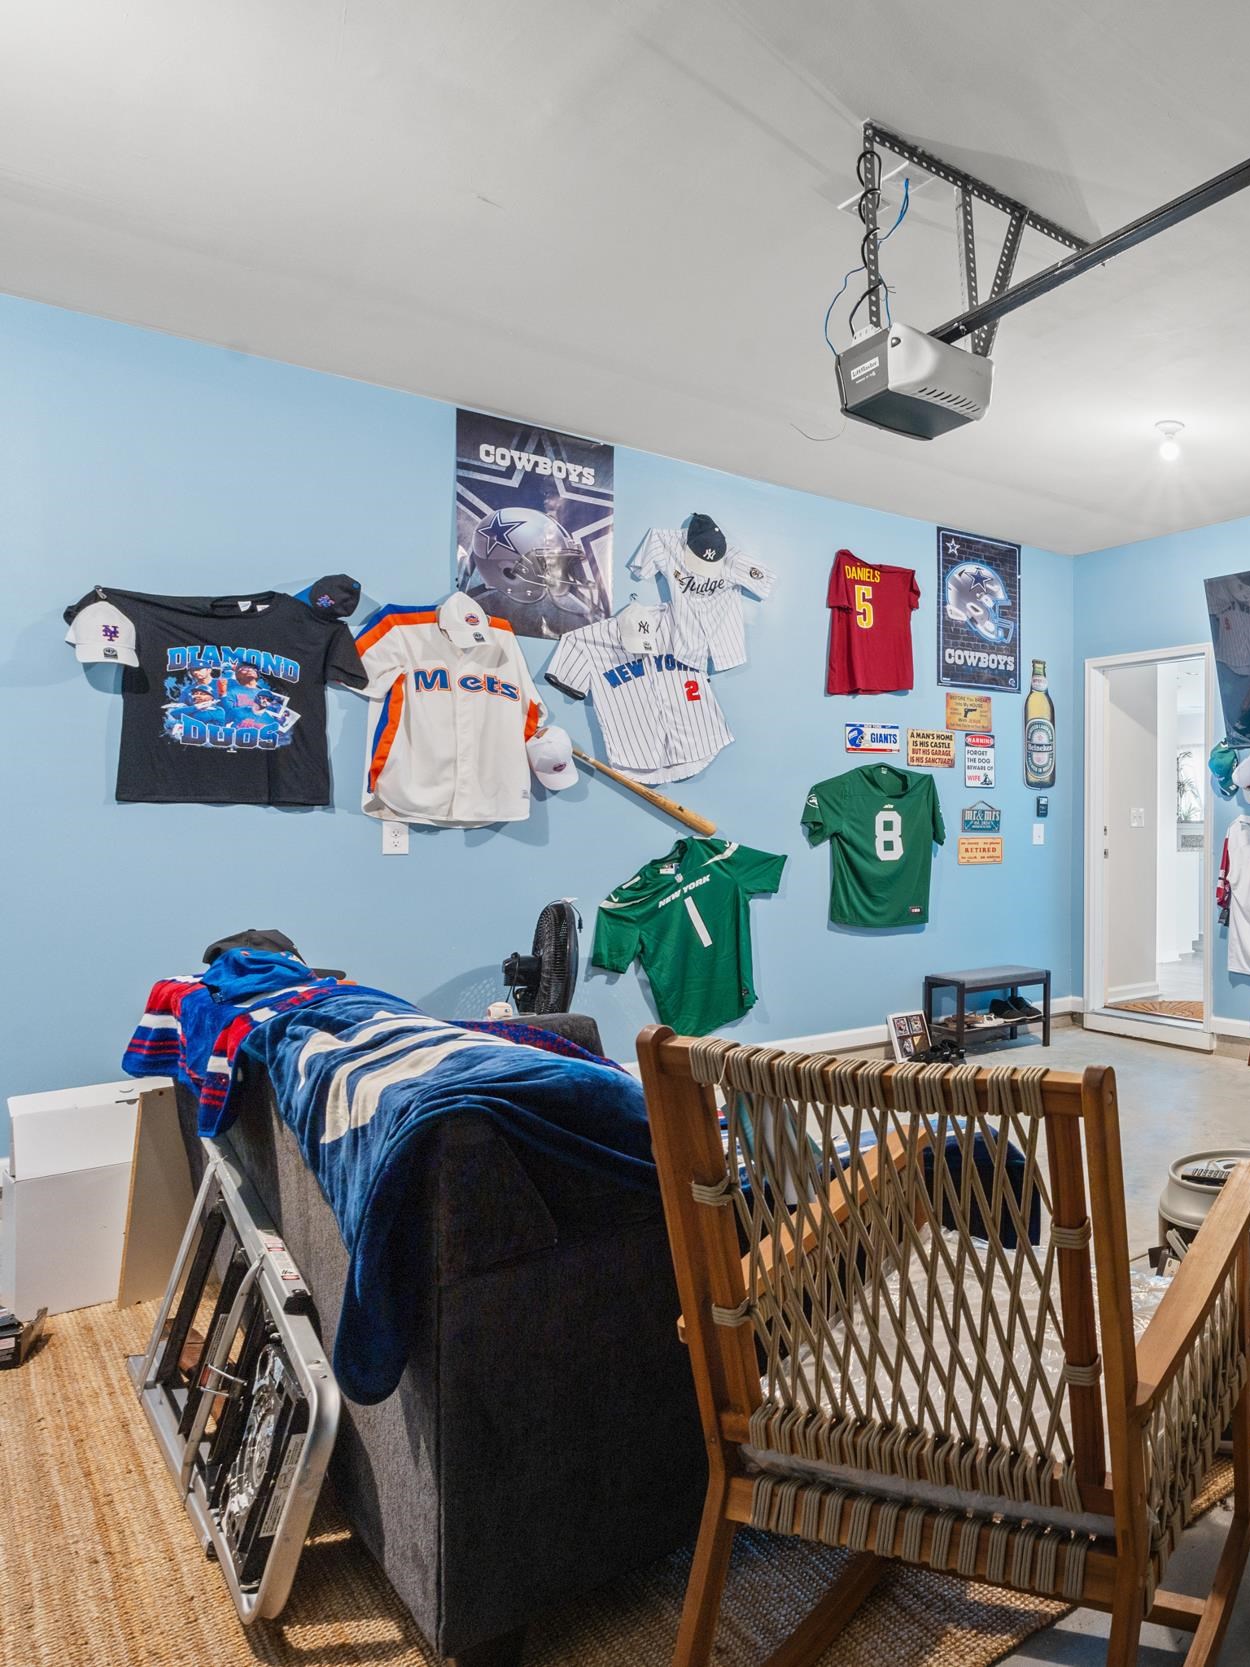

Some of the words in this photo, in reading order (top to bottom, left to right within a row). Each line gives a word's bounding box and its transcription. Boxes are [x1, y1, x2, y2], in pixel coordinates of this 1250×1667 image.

[479, 443, 595, 485] COWBOYS
[680, 576, 725, 596] Judge
[844, 564, 881, 584] DANIELS
[854, 584, 874, 629] 5
[166, 645, 301, 684] DIAMOND
[603, 658, 645, 688] NEW
[653, 653, 700, 673] YO
[945, 648, 1015, 671] COWBOYS
[413, 666, 521, 702] Mets
[684, 680, 701, 701] 2
[180, 713, 280, 750] DUOS
[870, 732, 898, 744] GIANTS
[930, 741, 951, 749] CASTLE
[925, 757, 953, 765] SANCTUARY
[931, 749, 951, 757] GARAGE
[875, 811, 904, 861] 8
[658, 889, 682, 909] NEW
[682, 874, 711, 894] YORK
[684, 896, 713, 948] 1
